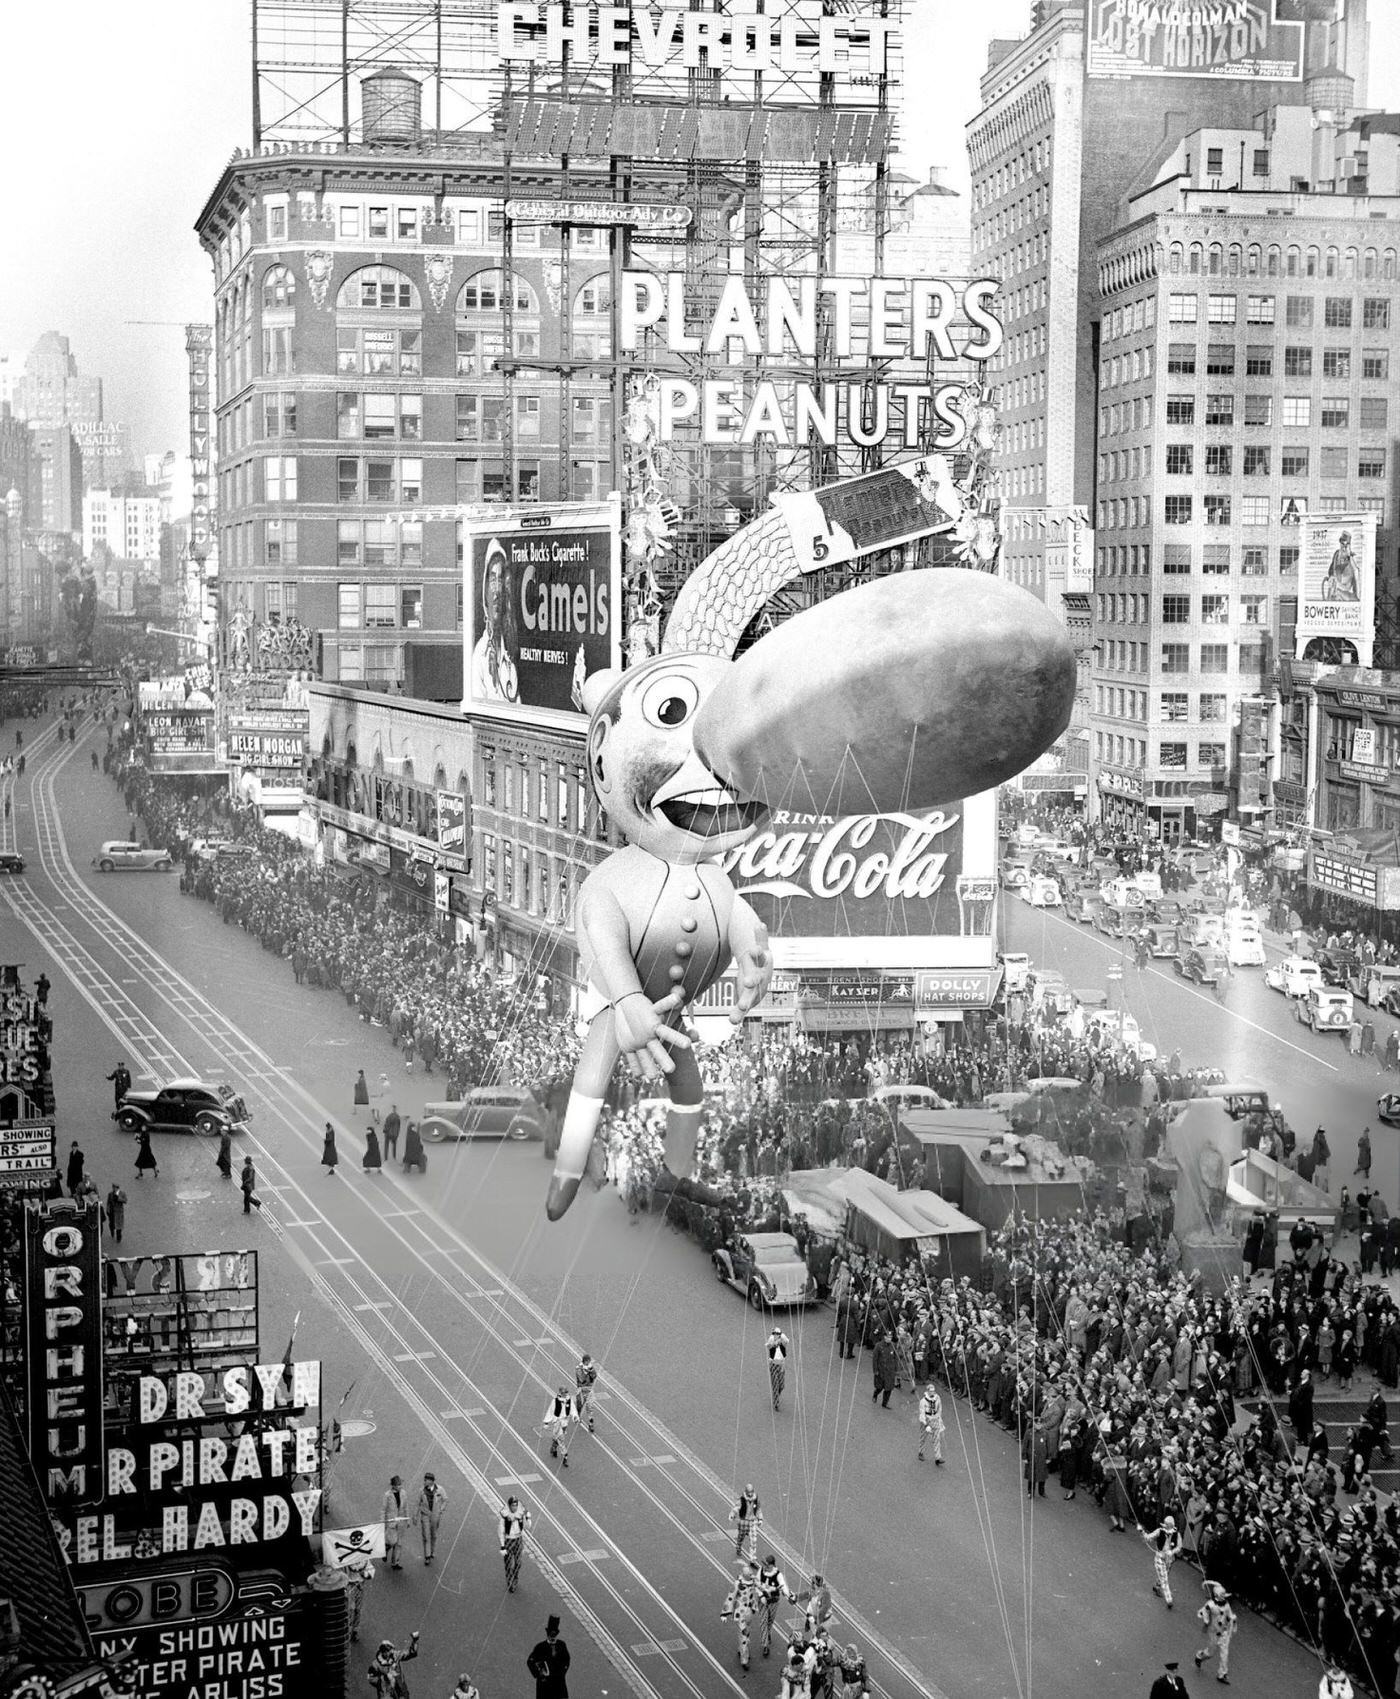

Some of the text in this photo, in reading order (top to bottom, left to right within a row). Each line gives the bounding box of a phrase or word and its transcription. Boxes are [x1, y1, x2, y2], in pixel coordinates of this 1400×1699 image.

[498, 3, 902, 73] CHEVROLET
[1162, 14, 1268, 67] HORIZON
[663, 208, 682, 222] Co
[621, 270, 1003, 361] PLANTERS
[660, 378, 966, 448] PEANUTS
[192, 350, 208, 544] HOLLYWOOD
[512, 543, 529, 563] Frank
[530, 541, 550, 562] Buck's
[1073, 520, 1082, 567] BECK
[521, 565, 609, 635] Camels
[1304, 606, 1340, 619] BOWERY
[520, 647, 542, 662] HEALTHY
[149, 717, 172, 728] LEON
[231, 735, 303, 755] HELEN MORGAN
[272, 755, 294, 766] SHOW
[715, 810, 961, 899] oca-Cola
[831, 985, 879, 996] KAYSER
[924, 992, 985, 1001] HAT SHOPS
[930, 980, 981, 991] DOLLY
[0, 1055, 39, 1083] ES
[3, 1128, 50, 1141] SHOWING
[30, 1144, 48, 1154] ALSO
[42, 1226, 86, 1497] ORPHEUM
[140, 1361, 321, 1424] DR SYN
[108, 1427, 318, 1496] R PIRATE
[163, 1489, 322, 1553] HARDY
[160, 1616, 285, 1655] SHOWING
[138, 1642, 301, 1687] TER PIRATE
